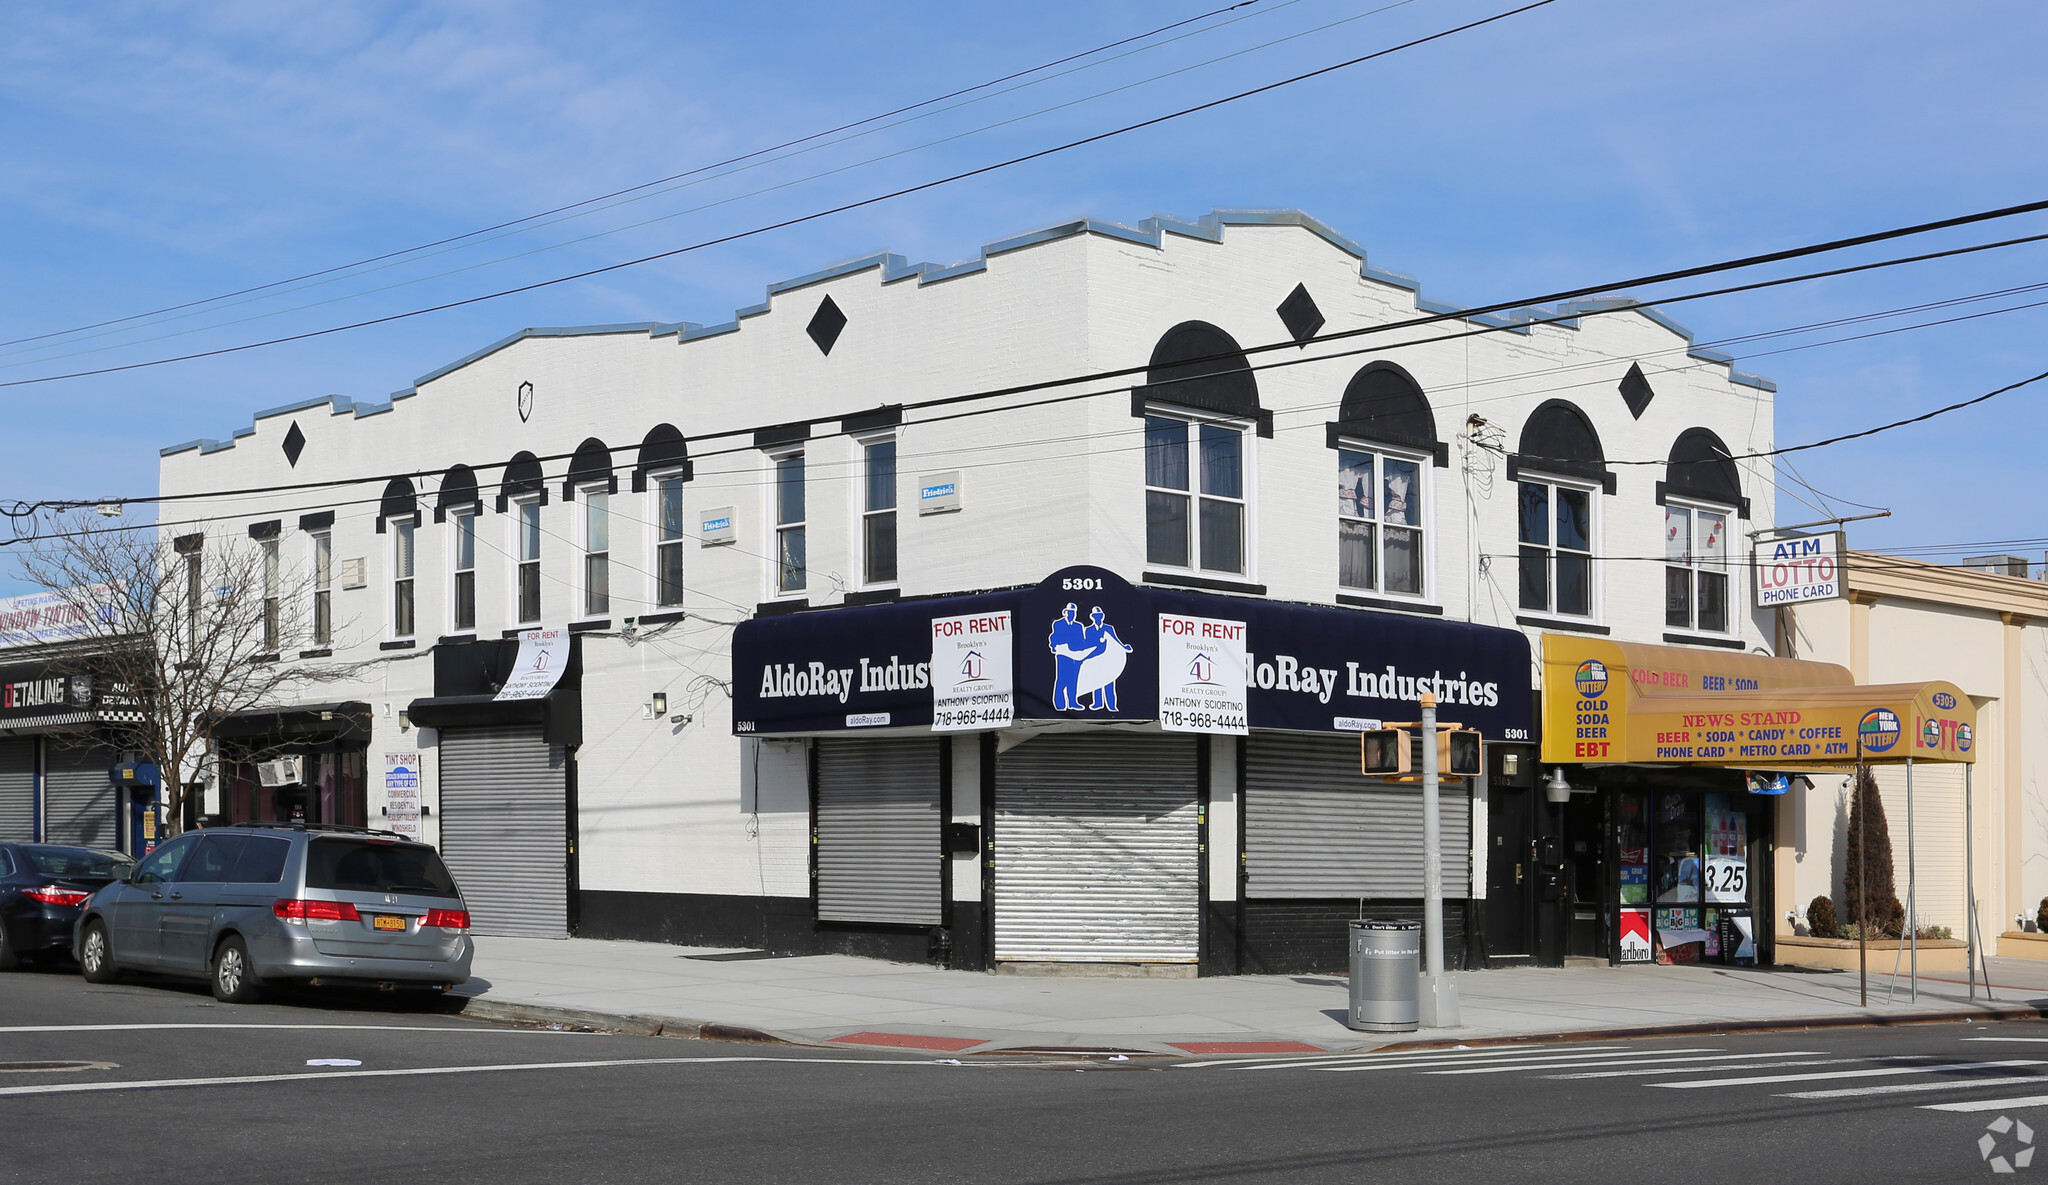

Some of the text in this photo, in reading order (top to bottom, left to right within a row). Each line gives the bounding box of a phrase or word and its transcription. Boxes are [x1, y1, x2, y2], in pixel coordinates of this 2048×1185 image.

[923, 484, 954, 498] Friedrich
[703, 518, 730, 531] Friedrich
[1773, 538, 1820, 560] ATM
[1761, 557, 1834, 588] LOTTO
[1062, 578, 1103, 590] 5301
[1764, 584, 1833, 602] PHONE CARD
[935, 616, 1007, 637] FOR RENT
[1163, 619, 1243, 640] FOR RENT
[527, 631, 559, 640] FOR RENT
[957, 641, 987, 650] Brooklyn's
[1186, 643, 1219, 652] Brooklyn's
[1591, 671, 1606, 680] YORK
[1632, 668, 1688, 688] COLD BEER
[760, 662, 853, 704] AldoRay
[1346, 661, 1498, 706] Industries
[1578, 681, 1606, 693] LOTTERY
[1703, 676, 1725, 690] BEER
[4, 678, 64, 708] DETAILING
[938, 694, 1009, 707] ANTHONY SCIORTINO
[1164, 697, 1243, 711] ANTHONY SCIORTINO
[1576, 700, 1608, 711] COLD
[1936, 694, 1954, 707] 5303
[850, 715, 885, 724] aldoRay.com
[935, 708, 1010, 726] 718-968-4444
[1162, 711, 1245, 729] 718-968-4444
[1576, 714, 1609, 725] SODA
[1683, 712, 1802, 728] NEWS STAND
[1879, 712, 1894, 720] NEW
[738, 722, 755, 731] 5301
[1338, 720, 1377, 730] aldoRay.com
[1879, 721, 1898, 731] YORK
[1505, 728, 1528, 739] 5301
[1577, 728, 1607, 738] BEER
[1657, 727, 1841, 743] BEER SODA CANDY COFFEE
[1861, 732, 1898, 746] LOTTERY
[1575, 742, 1610, 757] EBT
[1657, 743, 1848, 758] PHONE CARD METRO CARD ATM
[386, 754, 416, 765] TINT SHOP
[1763, 781, 1785, 790] HERE.
[388, 790, 416, 798] COMMERCIAL
[1705, 865, 1745, 892] 3.25
